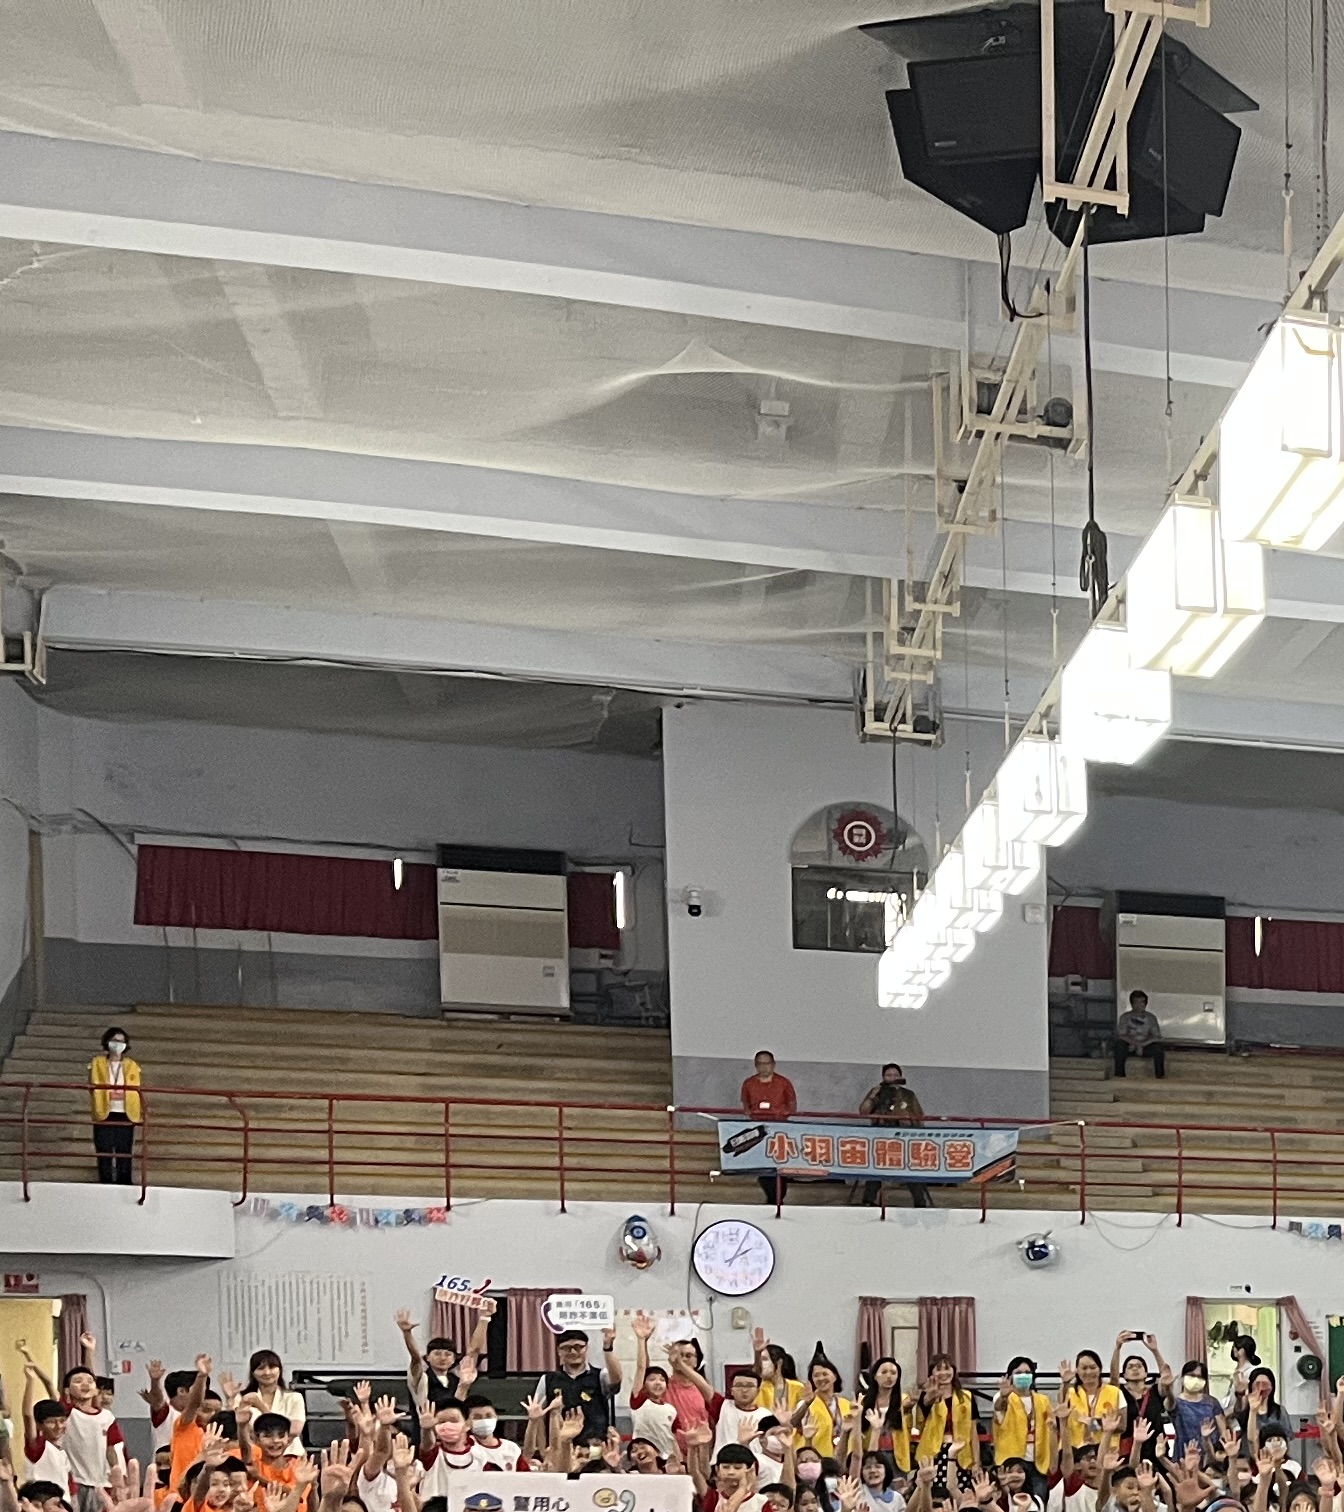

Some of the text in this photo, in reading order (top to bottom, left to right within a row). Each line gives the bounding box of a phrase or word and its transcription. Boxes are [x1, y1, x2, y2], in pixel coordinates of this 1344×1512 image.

[436, 1275, 470, 1291] 165
[513, 1496, 570, 1512] 警用心
